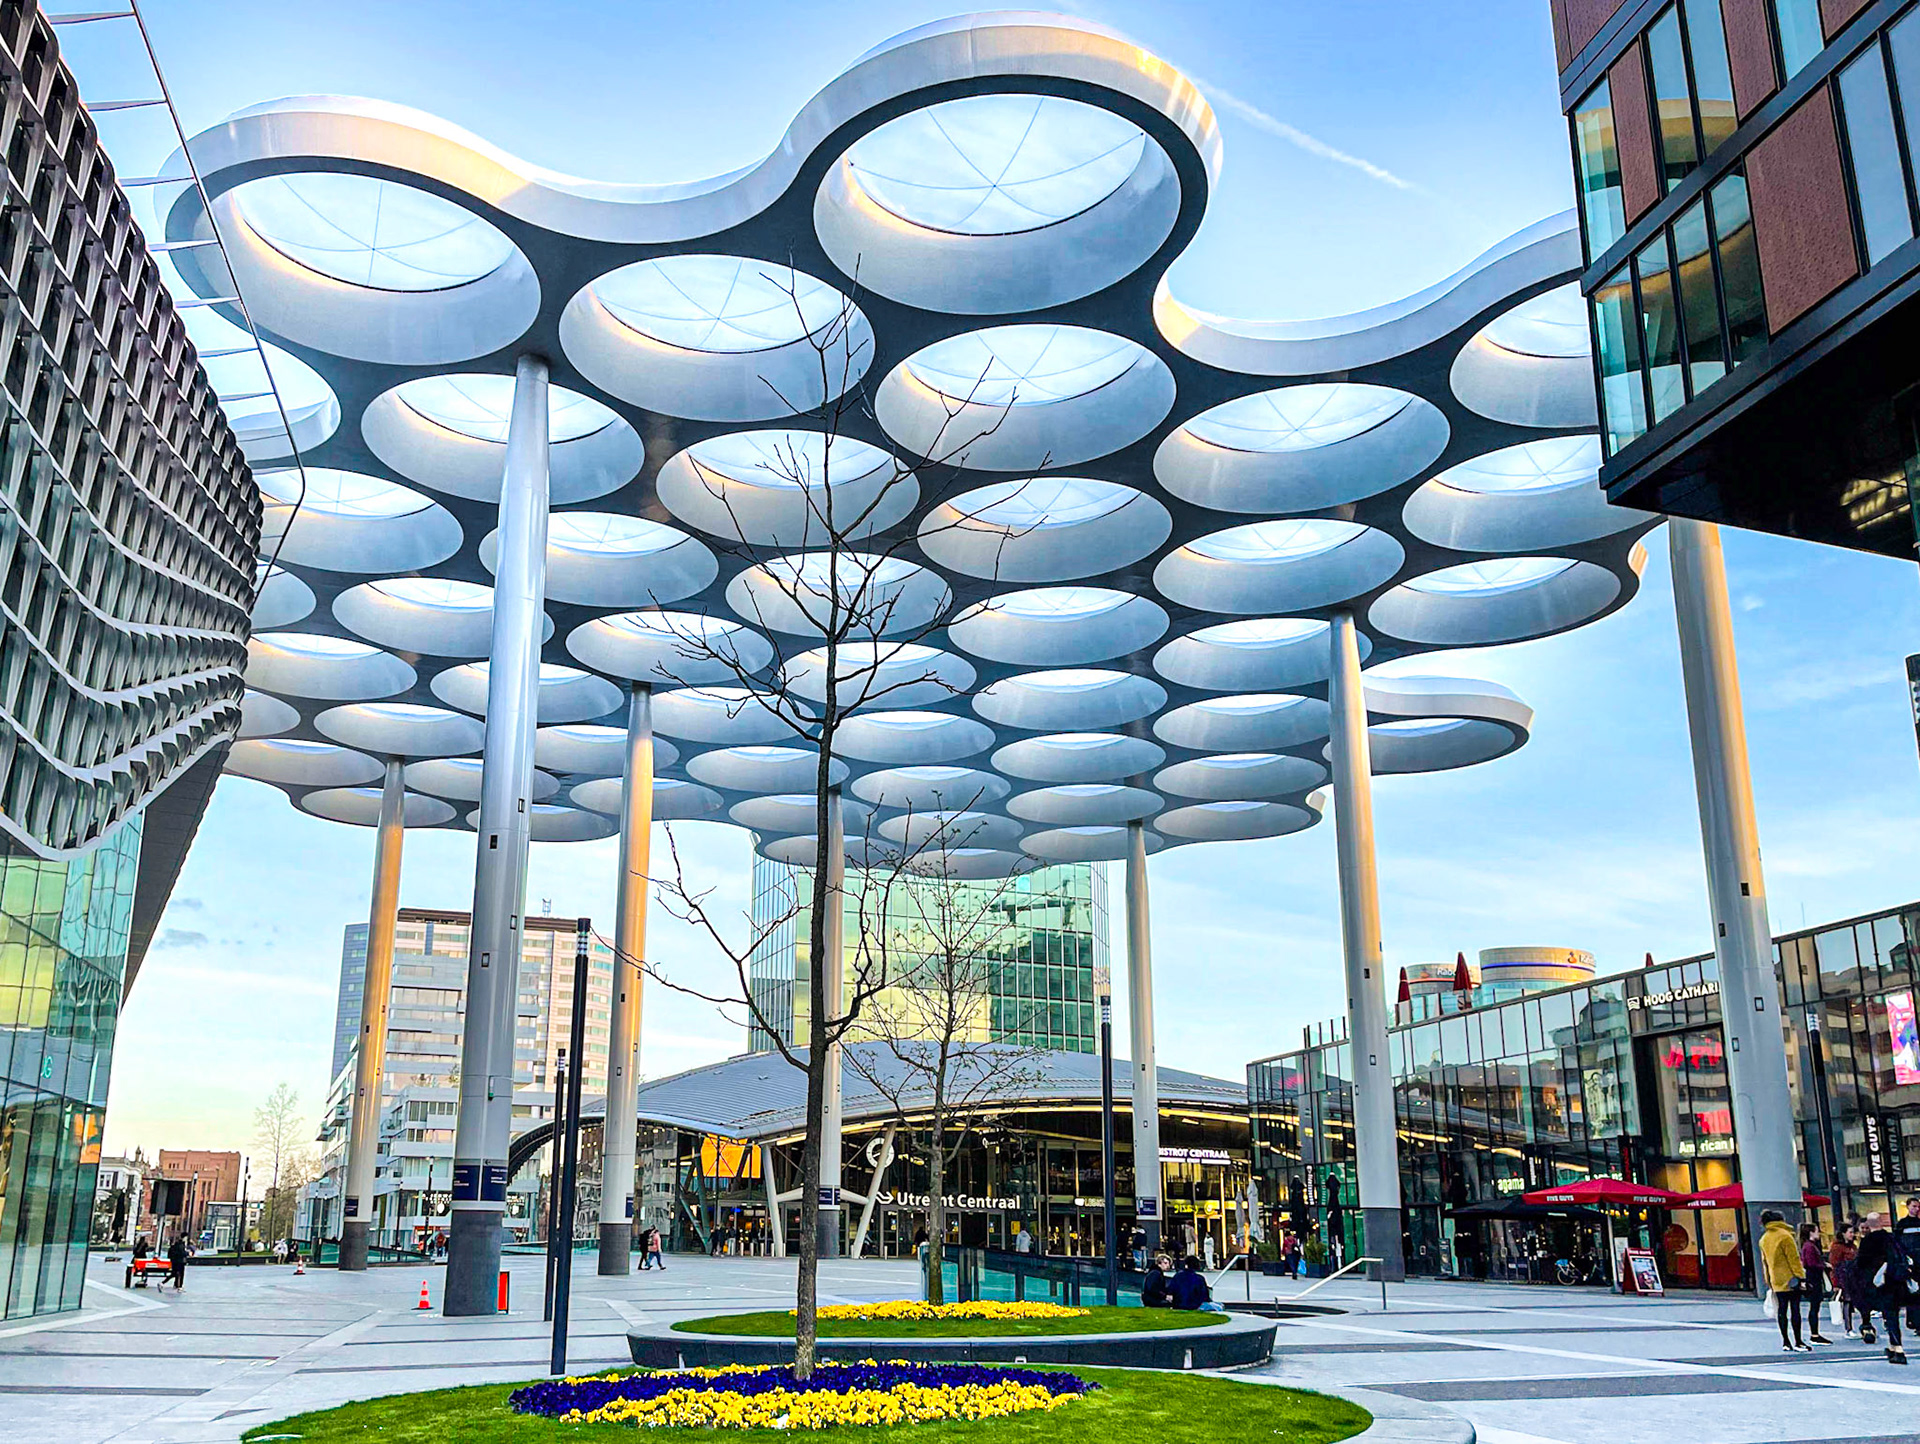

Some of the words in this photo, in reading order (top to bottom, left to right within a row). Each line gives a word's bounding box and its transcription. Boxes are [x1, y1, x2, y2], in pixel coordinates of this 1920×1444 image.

[1643, 991, 1674, 1007] HOOG
[1866, 1116, 1880, 1152] GUYS
[1189, 1148, 1230, 1158] CENTRAAL
[1678, 1139, 1728, 1153] Amrican
[1870, 1154, 1883, 1183] FIVE
[957, 1194, 1020, 1209] Centraal
[1559, 1194, 1574, 1202] GUYS
[1633, 1195, 1648, 1203] FIVE
[1648, 1196, 1667, 1204] GUYS
[1700, 1199, 1716, 1207] GUYS
